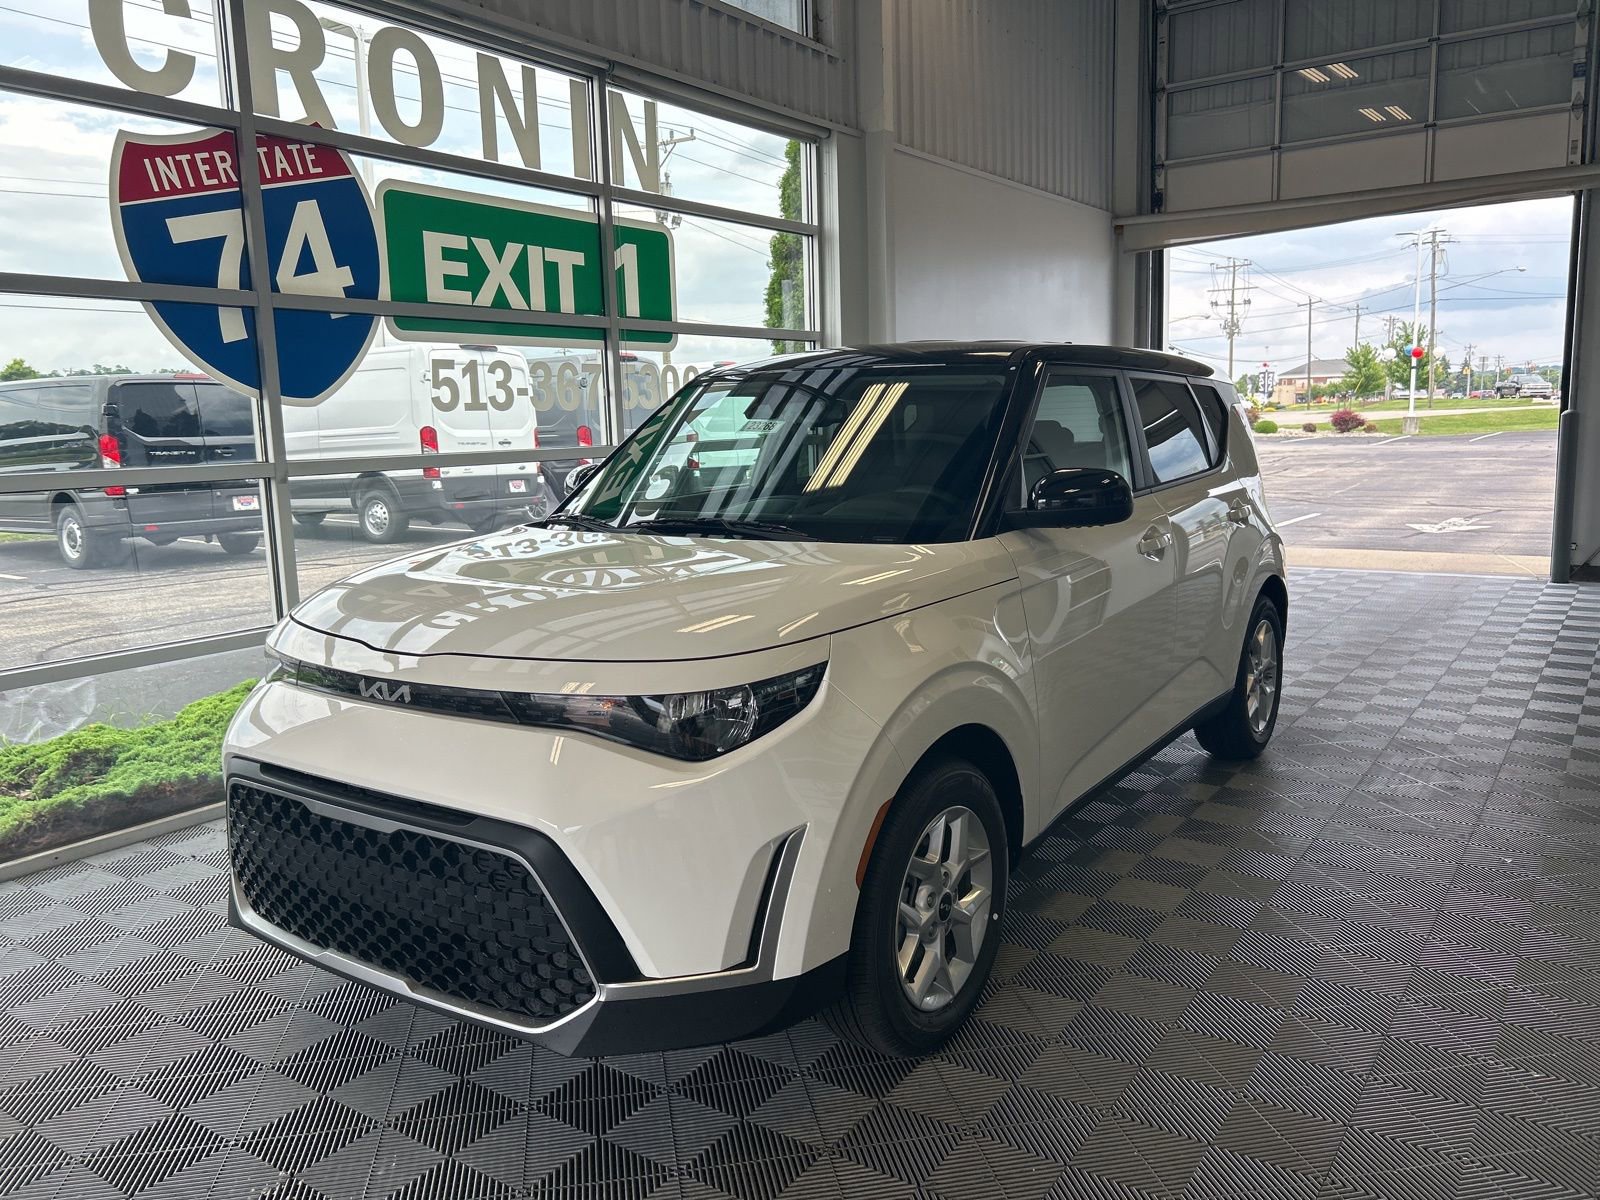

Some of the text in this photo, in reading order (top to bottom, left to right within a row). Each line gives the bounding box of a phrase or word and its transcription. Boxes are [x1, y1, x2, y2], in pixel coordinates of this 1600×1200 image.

[88, 0, 659, 194] CRONIN
[143, 143, 323, 192] INTERTATE
[165, 199, 355, 344] 74
[422, 230, 640, 318] EXIT 1
[430, 358, 700, 412] 513-367530
[359, 678, 412, 704] KIA
